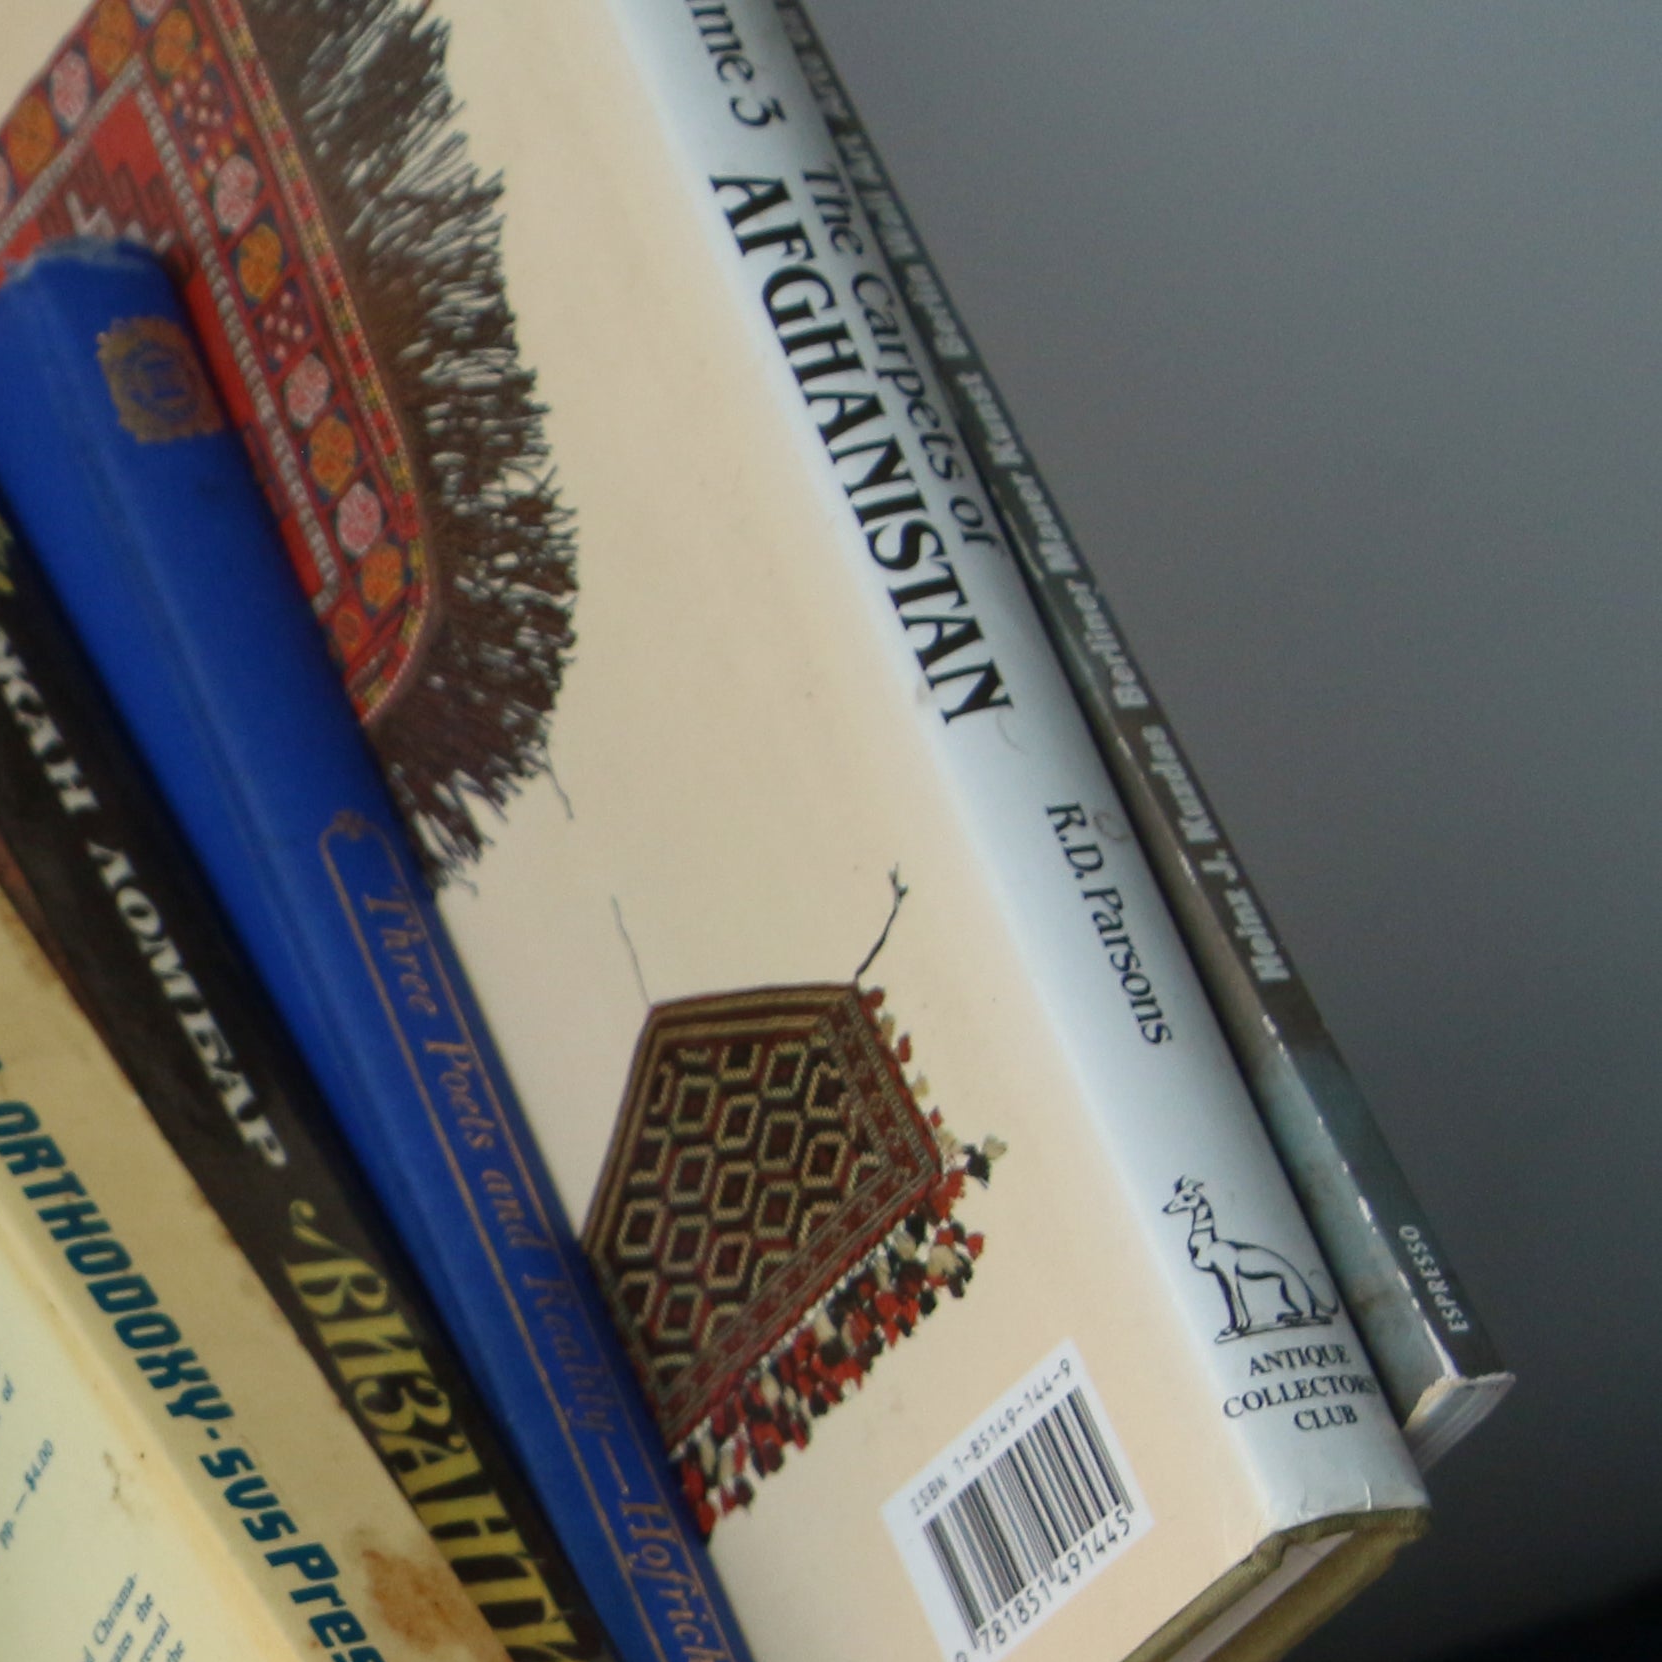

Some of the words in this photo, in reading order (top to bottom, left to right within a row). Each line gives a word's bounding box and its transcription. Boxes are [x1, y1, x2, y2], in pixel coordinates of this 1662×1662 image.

[729, 97, 788, 127] 3
[802, 163, 866, 256] The
[847, 269, 978, 482] Carpets
[948, 492, 1009, 559] of
[708, 176, 1015, 724] AFGHANISTAN
[1065, 578, 1148, 710] Berliner
[1045, 802, 1106, 879] R.D.
[1081, 886, 1174, 1045] Parsons
[1223, 888, 1290, 983] Heinz
[88, 844, 288, 1167] ЛОМБАР
[363, 893, 462, 1018] Three
[424, 1034, 515, 1152] Poets
[480, 1164, 548, 1247] and
[1398, 1222, 1469, 1335] ESPRESSO
[0, 1375, 15, 1404] of
[1248, 1343, 1351, 1377] ANTIQUE
[1294, 1404, 1358, 1431] CLUB
[911, 1476, 947, 1516] ISBN
[952, 1358, 1072, 1473] 1-85149-144-9
[134, 1590, 155, 1624] the
[974, 1578, 1051, 1653] 781851
[1049, 1508, 1130, 1586] 491445
